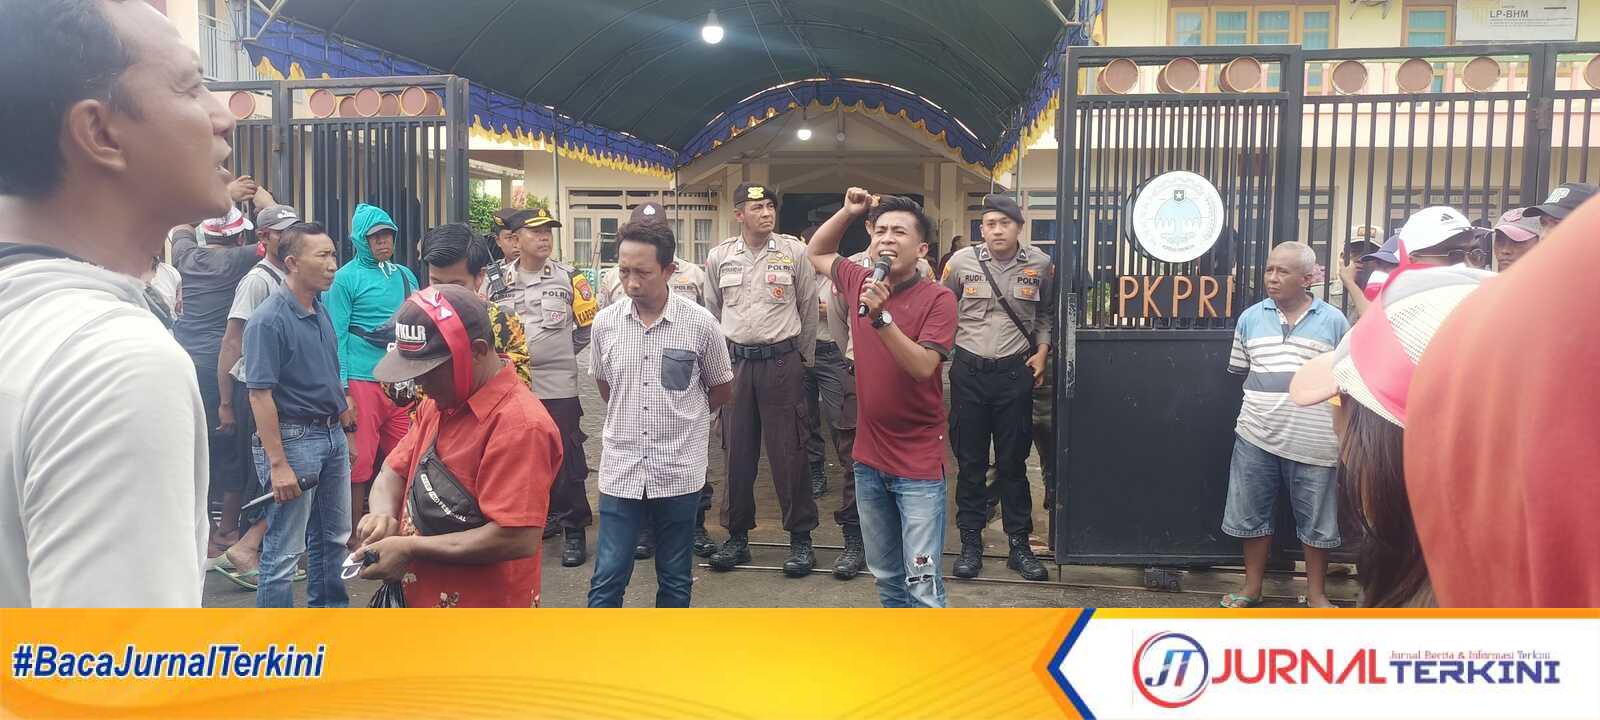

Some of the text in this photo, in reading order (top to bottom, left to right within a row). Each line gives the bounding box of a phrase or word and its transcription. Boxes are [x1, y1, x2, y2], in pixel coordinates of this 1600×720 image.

[1489, 10, 1529, 18] LP-BHM
[1017, 276, 1040, 286] POLRI
[542, 290, 569, 300] POLRI
[1119, 275, 1233, 318] PKPRI
